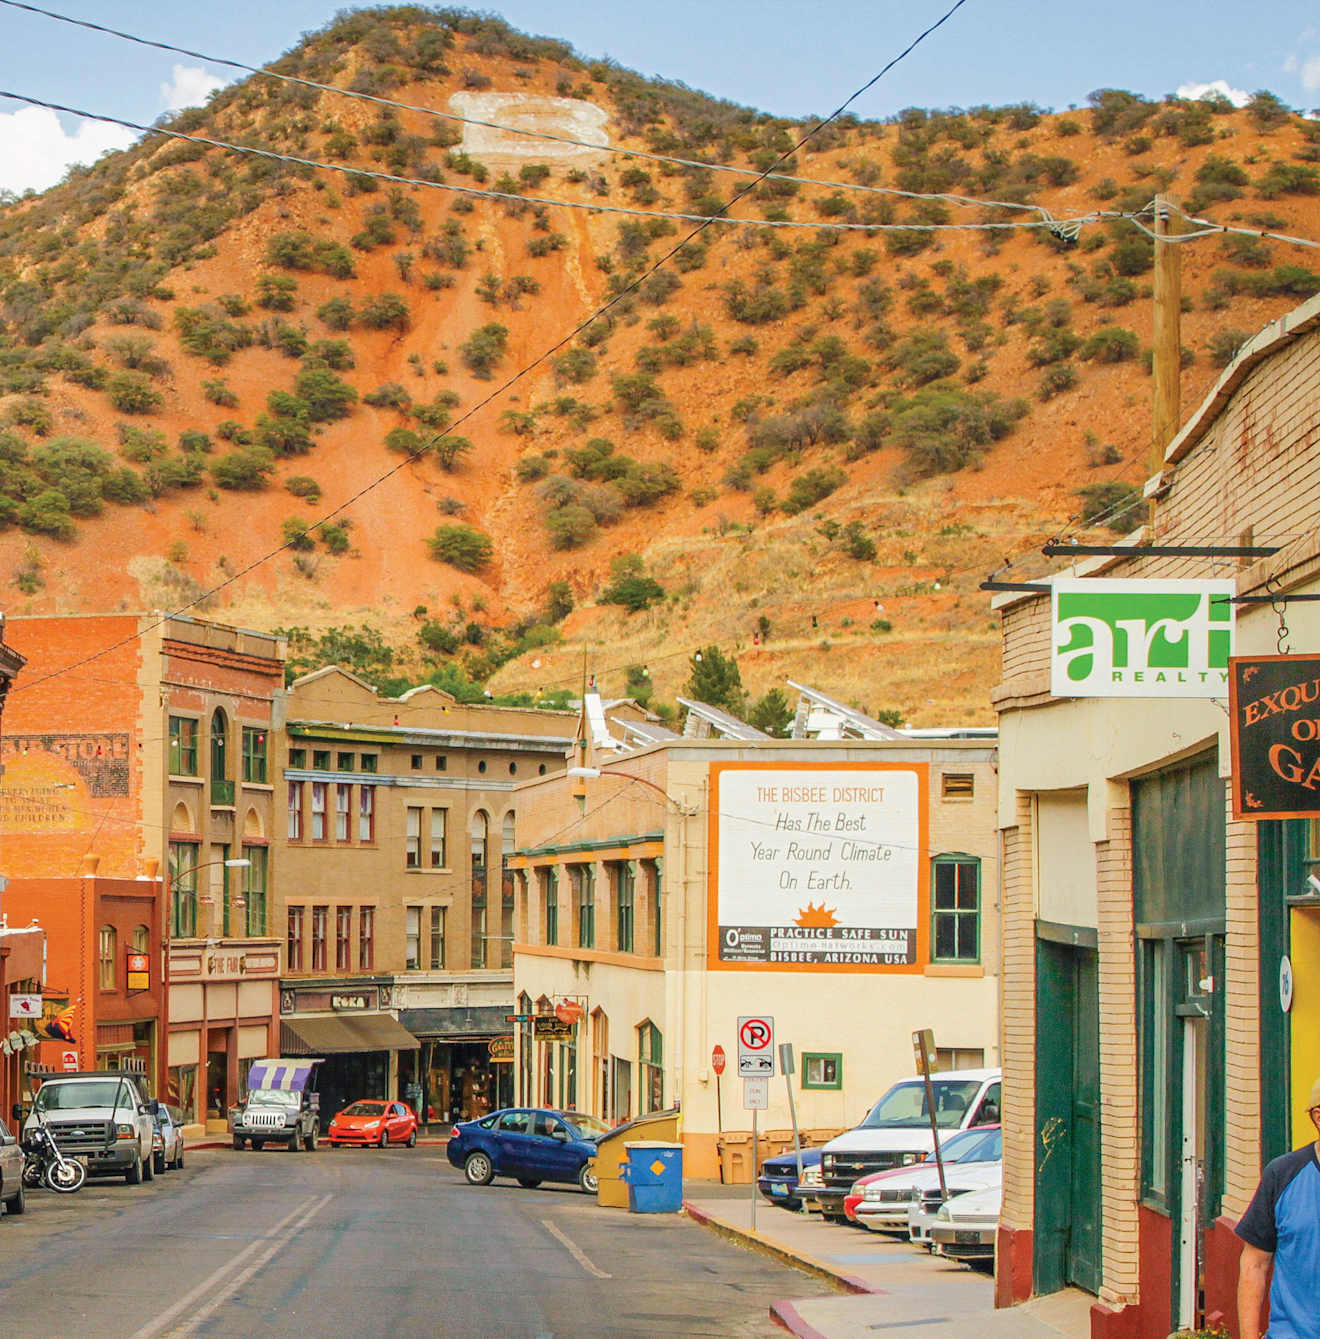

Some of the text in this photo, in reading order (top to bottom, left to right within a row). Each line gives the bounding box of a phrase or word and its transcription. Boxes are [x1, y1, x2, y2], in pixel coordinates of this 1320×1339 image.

[1111, 671, 1228, 683] REALTY
[757, 787, 886, 803] THE BISBEE DISTRICT
[776, 812, 867, 831] Has The Best
[750, 841, 892, 861] Year Round Climate
[779, 870, 854, 890] On Earth.
[770, 928, 908, 941] PRACTICE SAFE SUN
[770, 952, 818, 964] BISBEE,
[824, 953, 878, 964] ARIZONA
[884, 954, 908, 965] USA
[712, 1053, 726, 1067] STOP
